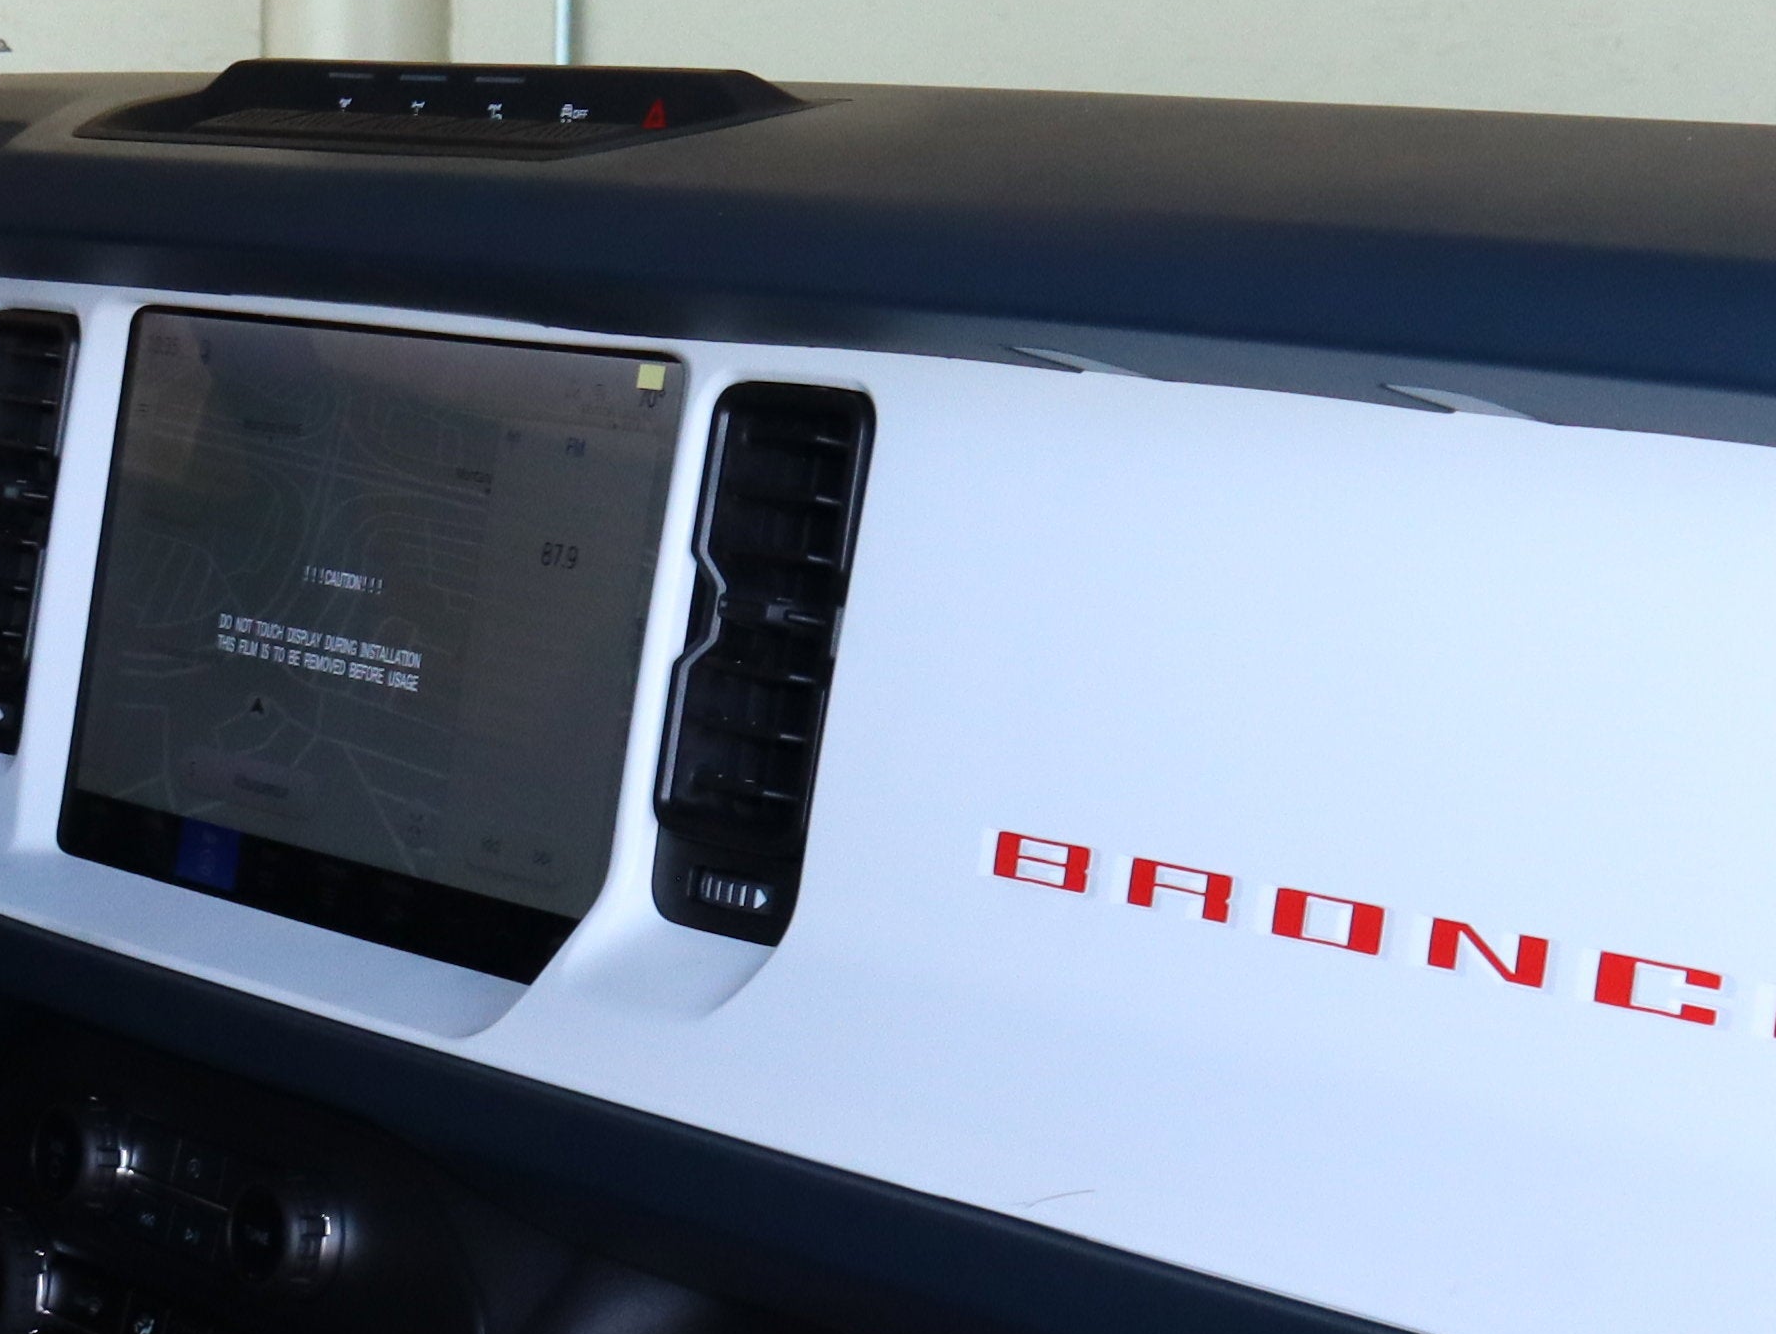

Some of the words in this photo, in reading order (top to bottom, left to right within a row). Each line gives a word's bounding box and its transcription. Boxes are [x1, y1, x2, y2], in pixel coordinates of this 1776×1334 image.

[540, 540, 579, 571] 87.9
[217, 634, 237, 653] THIS
[238, 639, 258, 657] FILM
[260, 643, 269, 659] IS
[274, 646, 286, 662] TO
[288, 650, 302, 667] BE
[303, 653, 346, 676] REMOVED
[348, 662, 385, 685] BEFORE
[387, 672, 420, 692] USAGE
[218, 613, 233, 629] DO
[235, 617, 253, 633] NOT
[257, 620, 284, 640] TOUCH
[286, 627, 323, 648] DISPLAY
[324, 635, 358, 656] DURING
[359, 642, 422, 669] INSTALLATION
